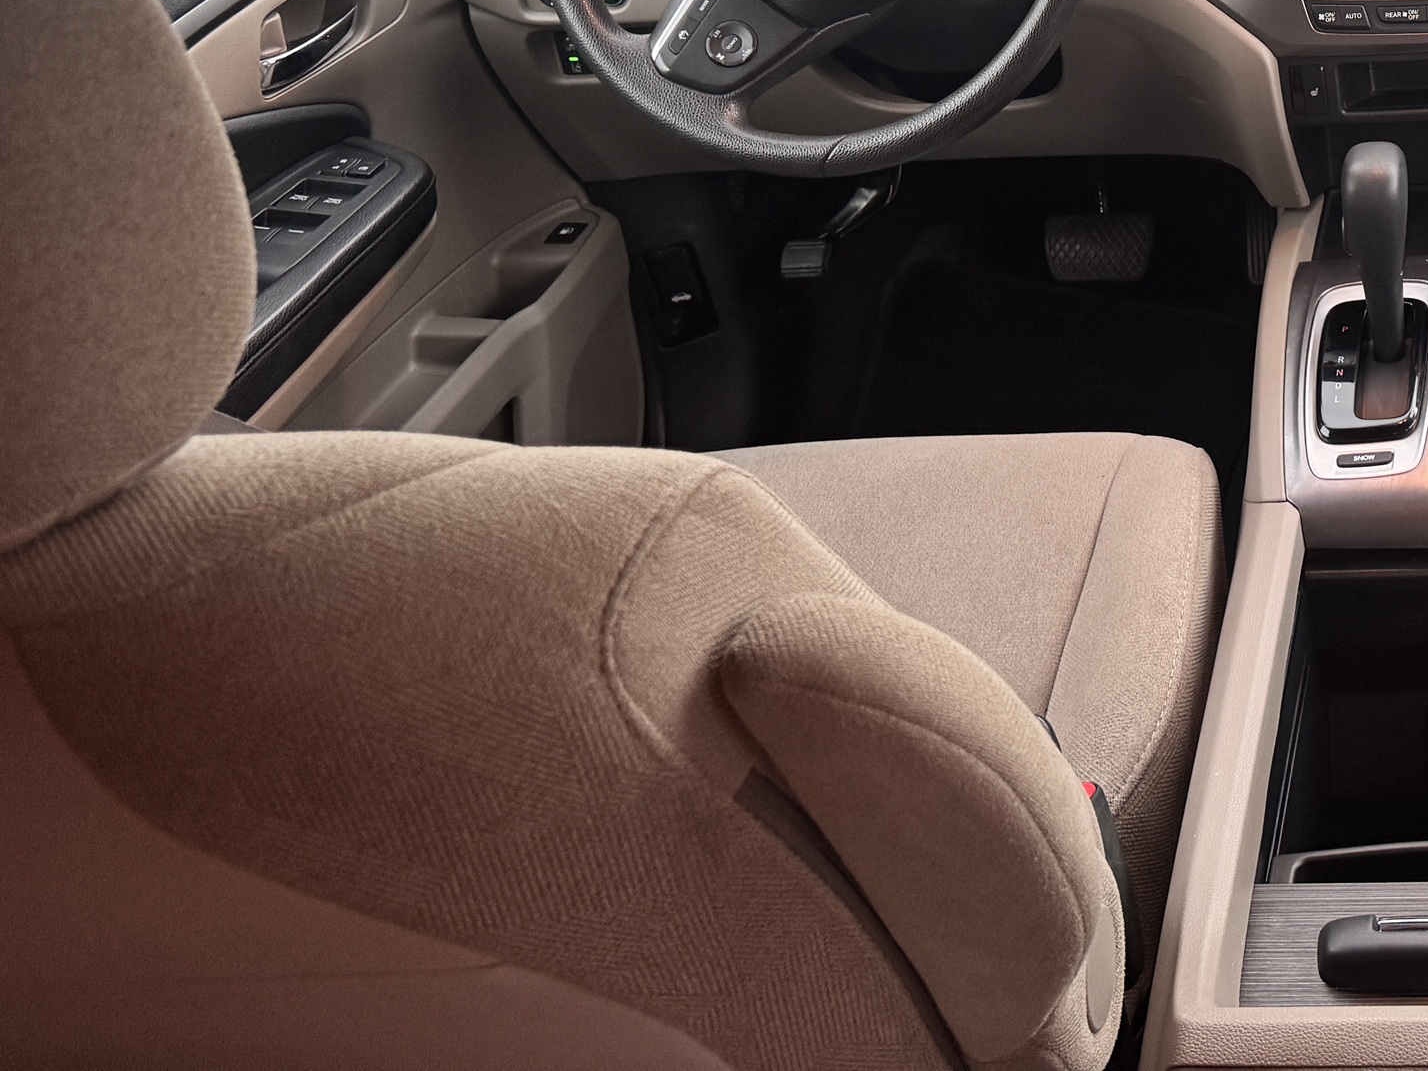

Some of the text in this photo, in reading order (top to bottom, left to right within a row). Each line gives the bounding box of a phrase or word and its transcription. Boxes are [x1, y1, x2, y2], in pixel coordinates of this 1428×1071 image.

[1345, 12, 1362, 20] AUTO
[1385, 11, 1402, 19] REAR
[1353, 454, 1375, 462] SNOW
